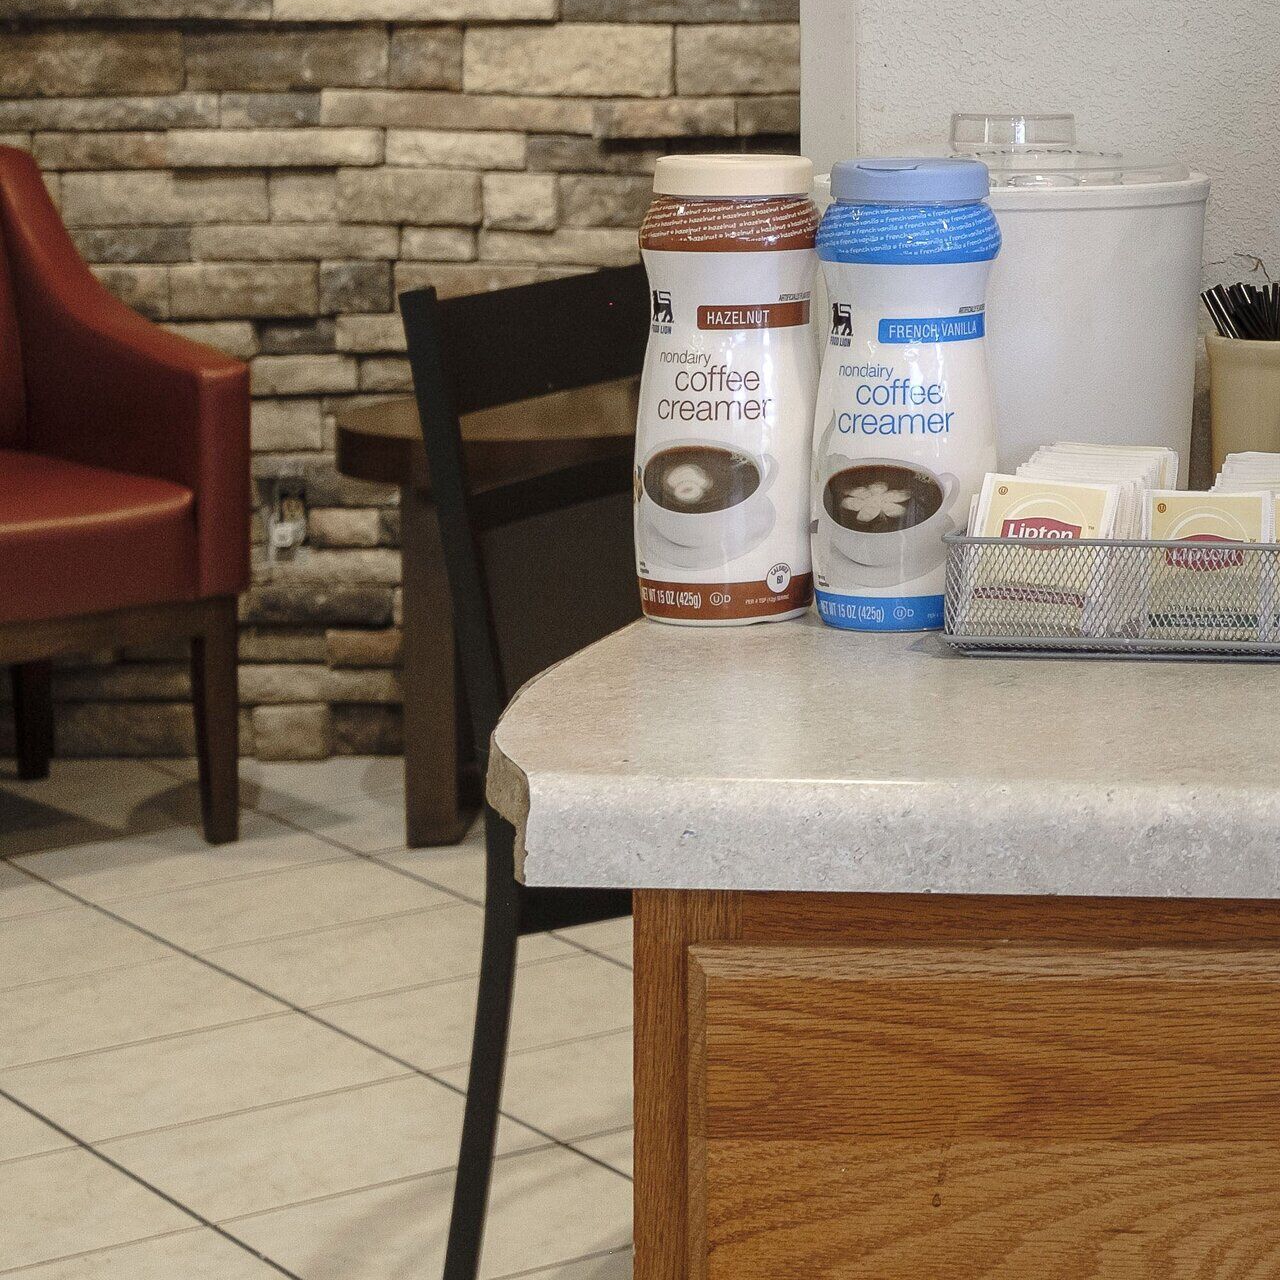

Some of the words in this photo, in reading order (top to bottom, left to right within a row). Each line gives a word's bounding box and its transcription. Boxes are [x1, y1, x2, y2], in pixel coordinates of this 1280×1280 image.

[706, 310, 770, 325] HAZELNUT
[889, 324, 938, 339] FRENCH
[941, 320, 977, 336] VANILLA
[660, 350, 711, 367] nondairy
[675, 365, 760, 392] coffee
[838, 363, 894, 381] nondairy
[856, 378, 943, 405] coffee
[658, 398, 772, 421] creamer
[838, 411, 955, 435] creamer
[665, 591, 676, 606] OZ
[676, 591, 702, 609] (425g)
[838, 604, 846, 618] 15
[846, 605, 857, 620] OZ
[858, 605, 885, 623] (425g)
